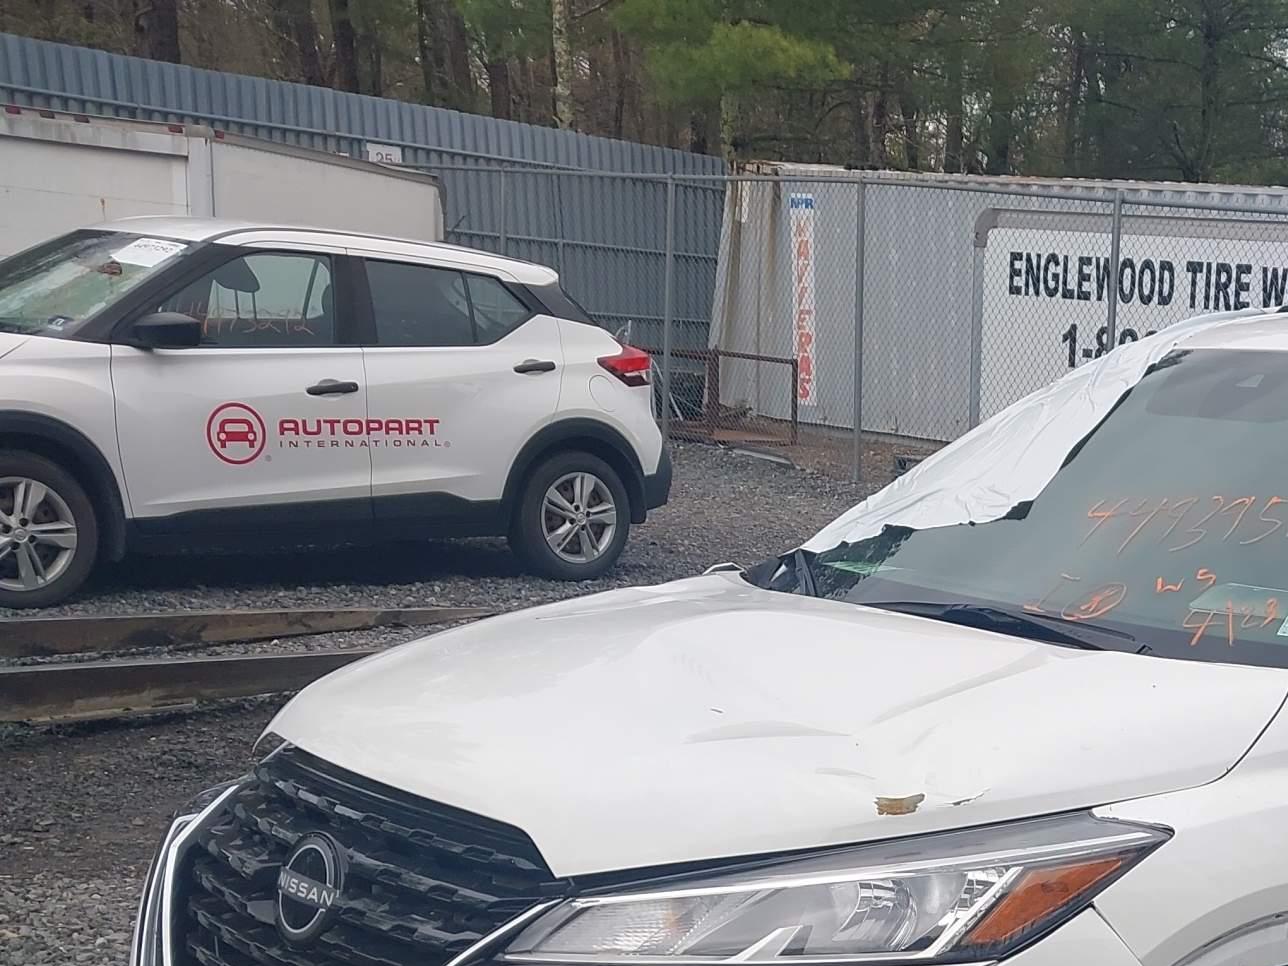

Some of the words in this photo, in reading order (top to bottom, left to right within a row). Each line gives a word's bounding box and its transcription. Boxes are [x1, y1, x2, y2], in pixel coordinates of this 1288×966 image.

[1008, 251, 1175, 306] ENGLEWOOD
[1186, 260, 1252, 312] TIRE
[279, 418, 440, 436] AUTOPART
[279, 439, 441, 448] INTERNATIONAL
[278, 871, 335, 907] NISSAN
